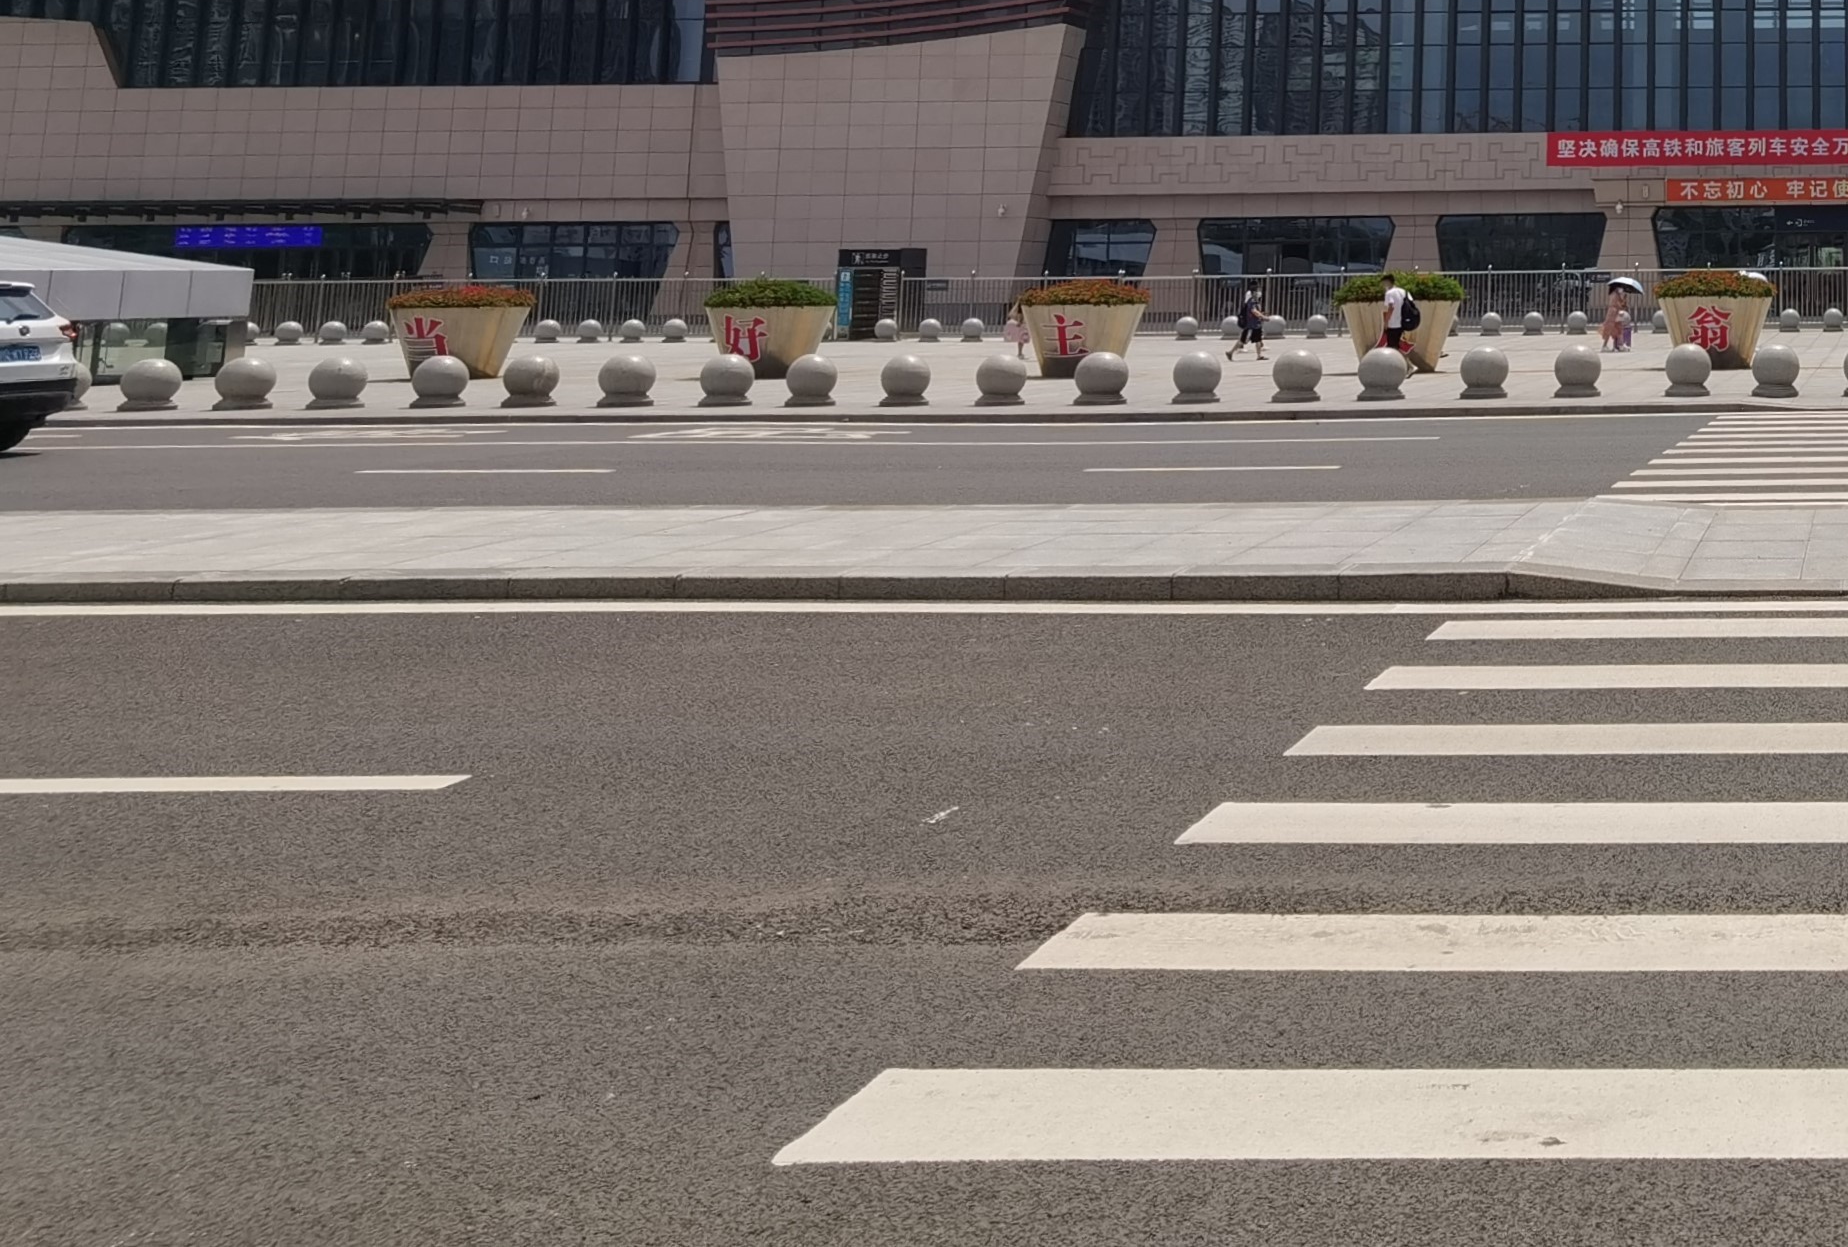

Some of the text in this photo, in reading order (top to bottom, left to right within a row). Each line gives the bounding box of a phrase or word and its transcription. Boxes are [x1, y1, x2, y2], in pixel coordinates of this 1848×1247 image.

[1680, 180, 1768, 200] 不忘初心
[404, 315, 448, 361] 当
[723, 313, 769, 362] 好
[1043, 314, 1089, 358] 主
[1687, 305, 1732, 352] 翁
